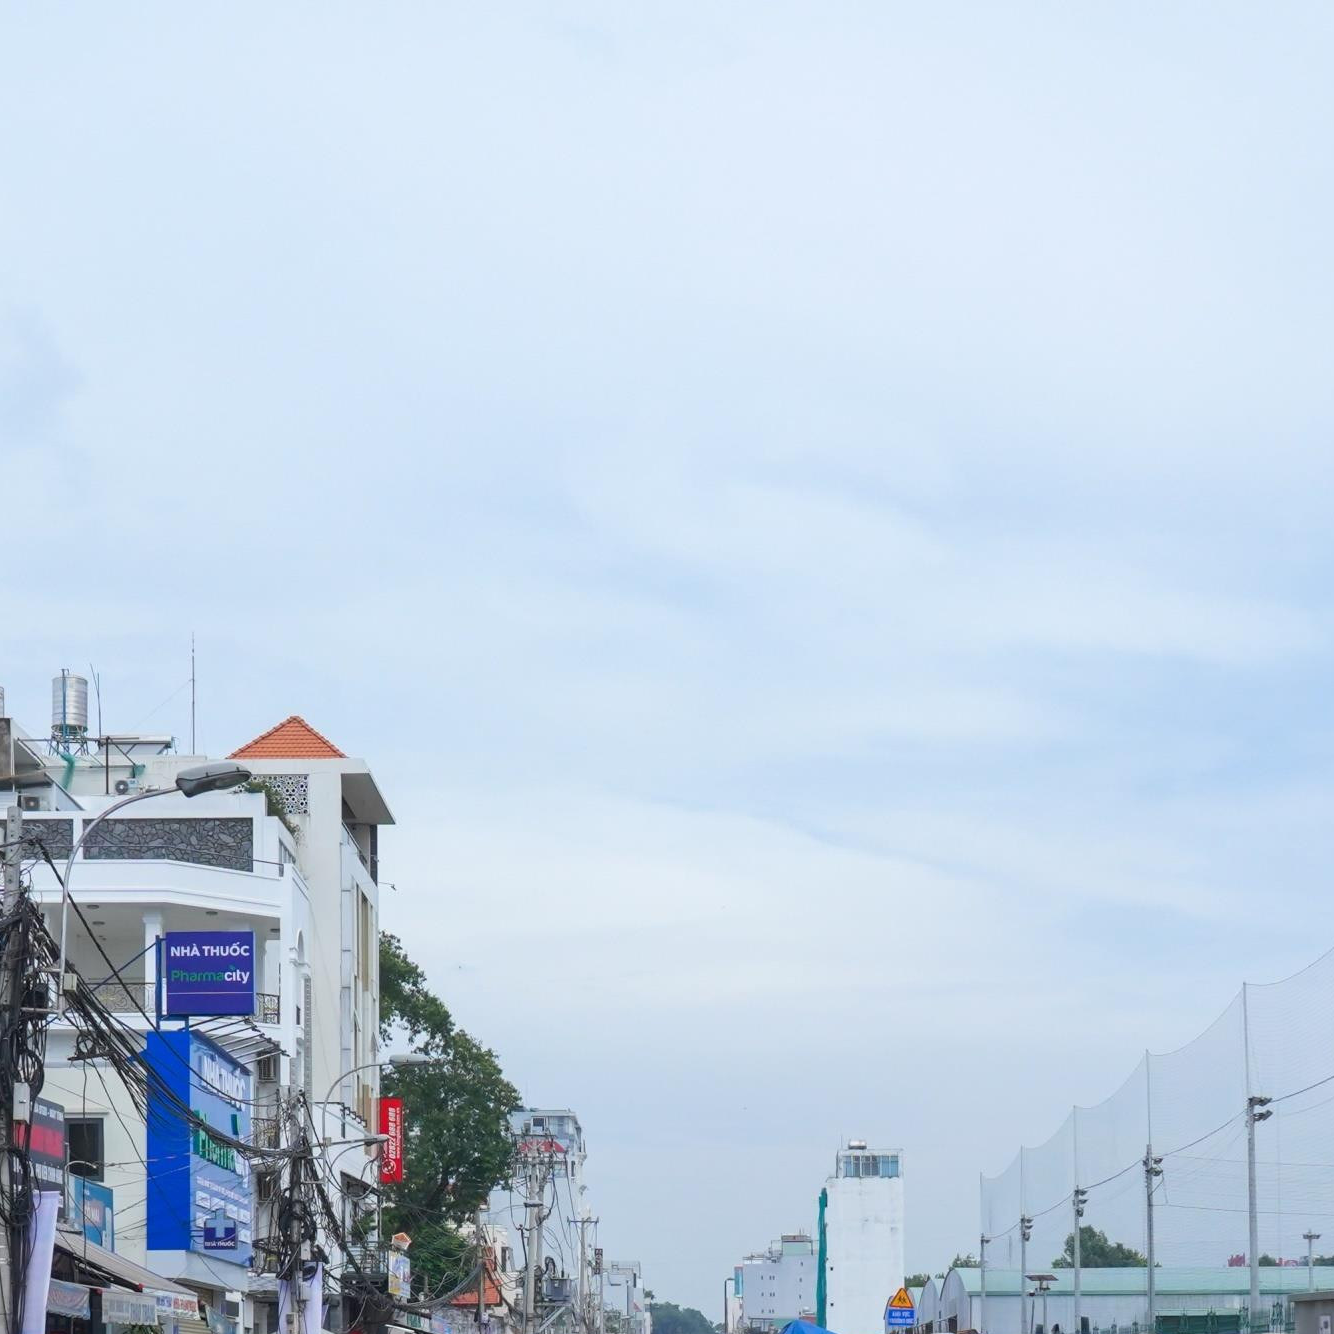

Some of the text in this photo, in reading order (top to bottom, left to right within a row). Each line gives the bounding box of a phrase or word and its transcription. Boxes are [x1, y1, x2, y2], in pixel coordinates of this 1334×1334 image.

[170, 941, 251, 958] NHÀ THUỐC
[170, 964, 251, 985] Pharmacity
